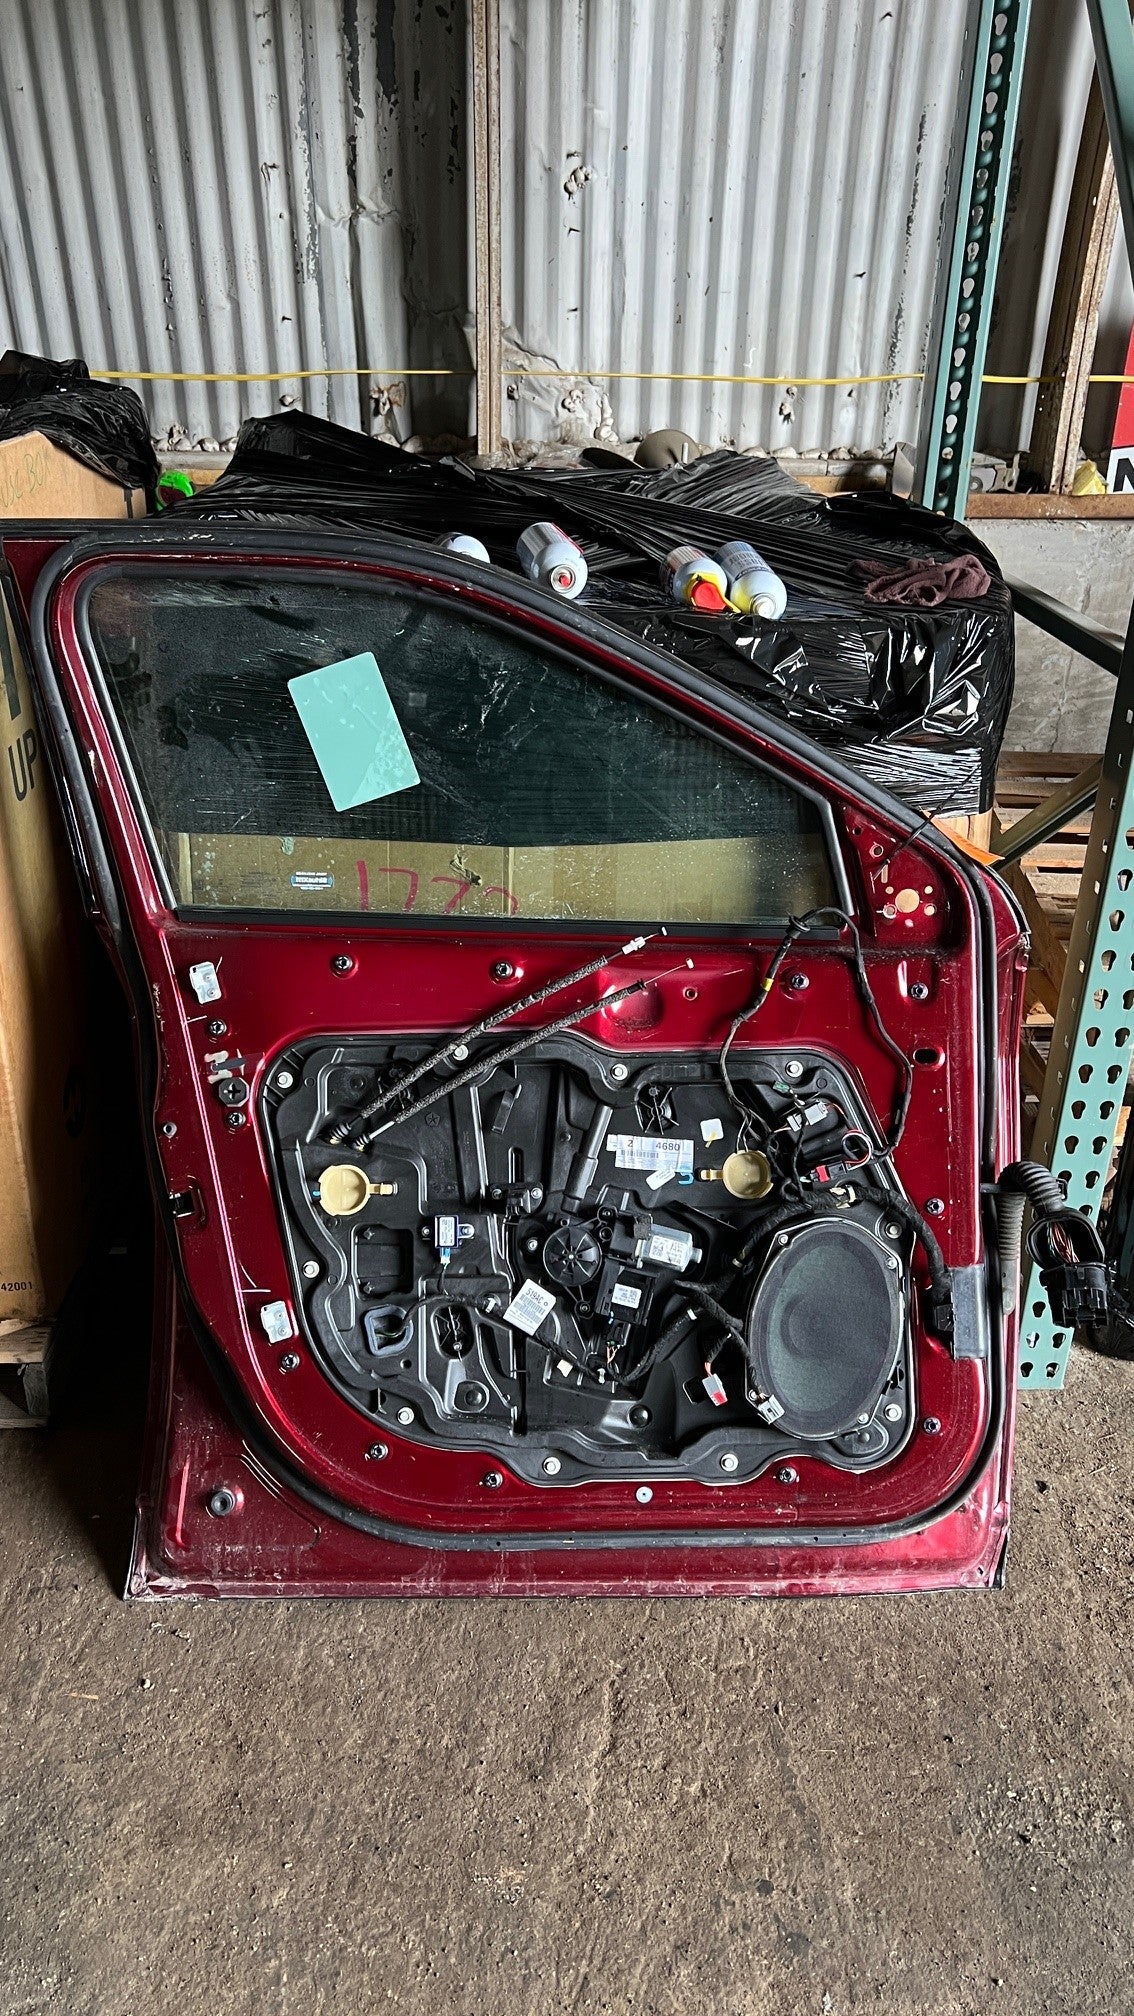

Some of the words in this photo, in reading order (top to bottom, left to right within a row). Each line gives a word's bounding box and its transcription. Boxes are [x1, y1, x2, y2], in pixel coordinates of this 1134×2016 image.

[8, 728, 37, 801] UP
[655, 1142, 681, 1151] 4680
[0, 1281, 33, 1292] 42001
